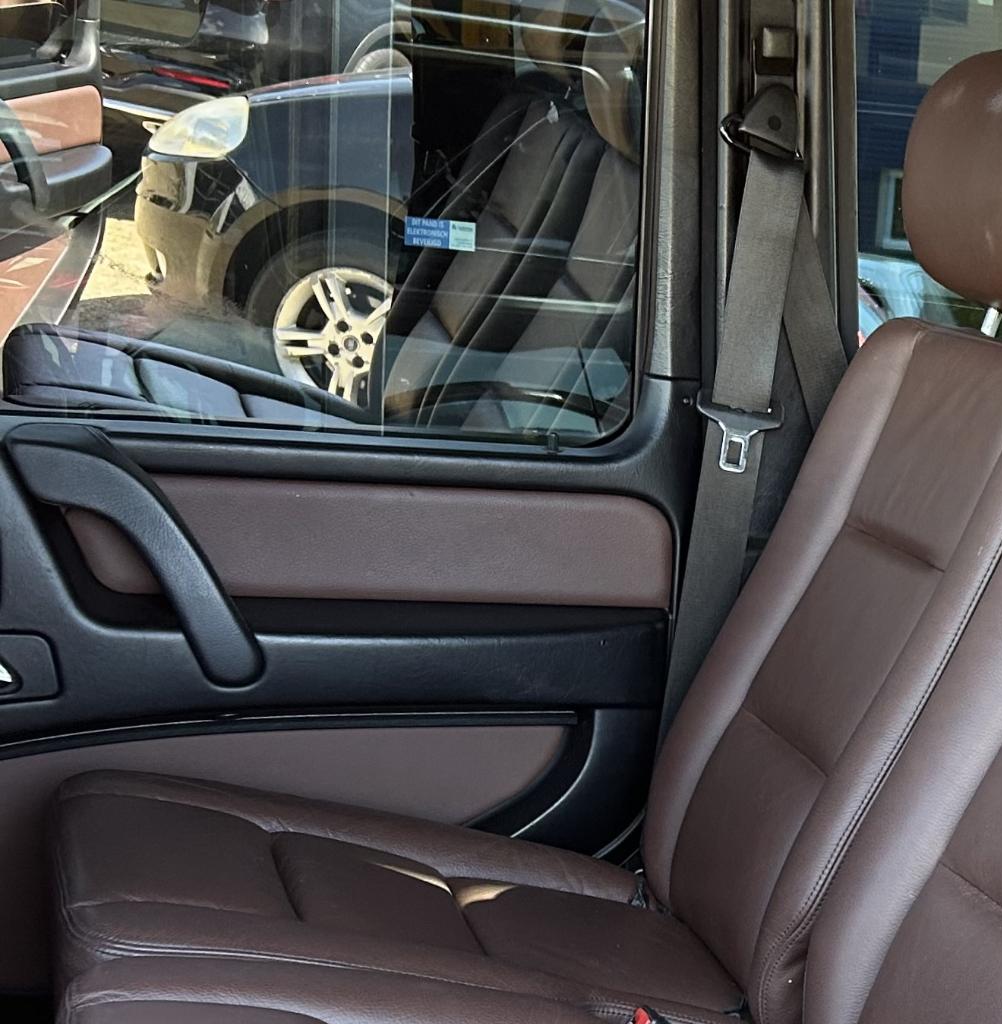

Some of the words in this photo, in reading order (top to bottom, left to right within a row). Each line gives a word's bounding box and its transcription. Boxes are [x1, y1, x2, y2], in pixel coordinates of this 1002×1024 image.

[411, 218, 420, 227] DIT
[422, 219, 437, 227] PAND
[438, 220, 444, 228] IS
[407, 227, 448, 238] ELEKTRONISCH
